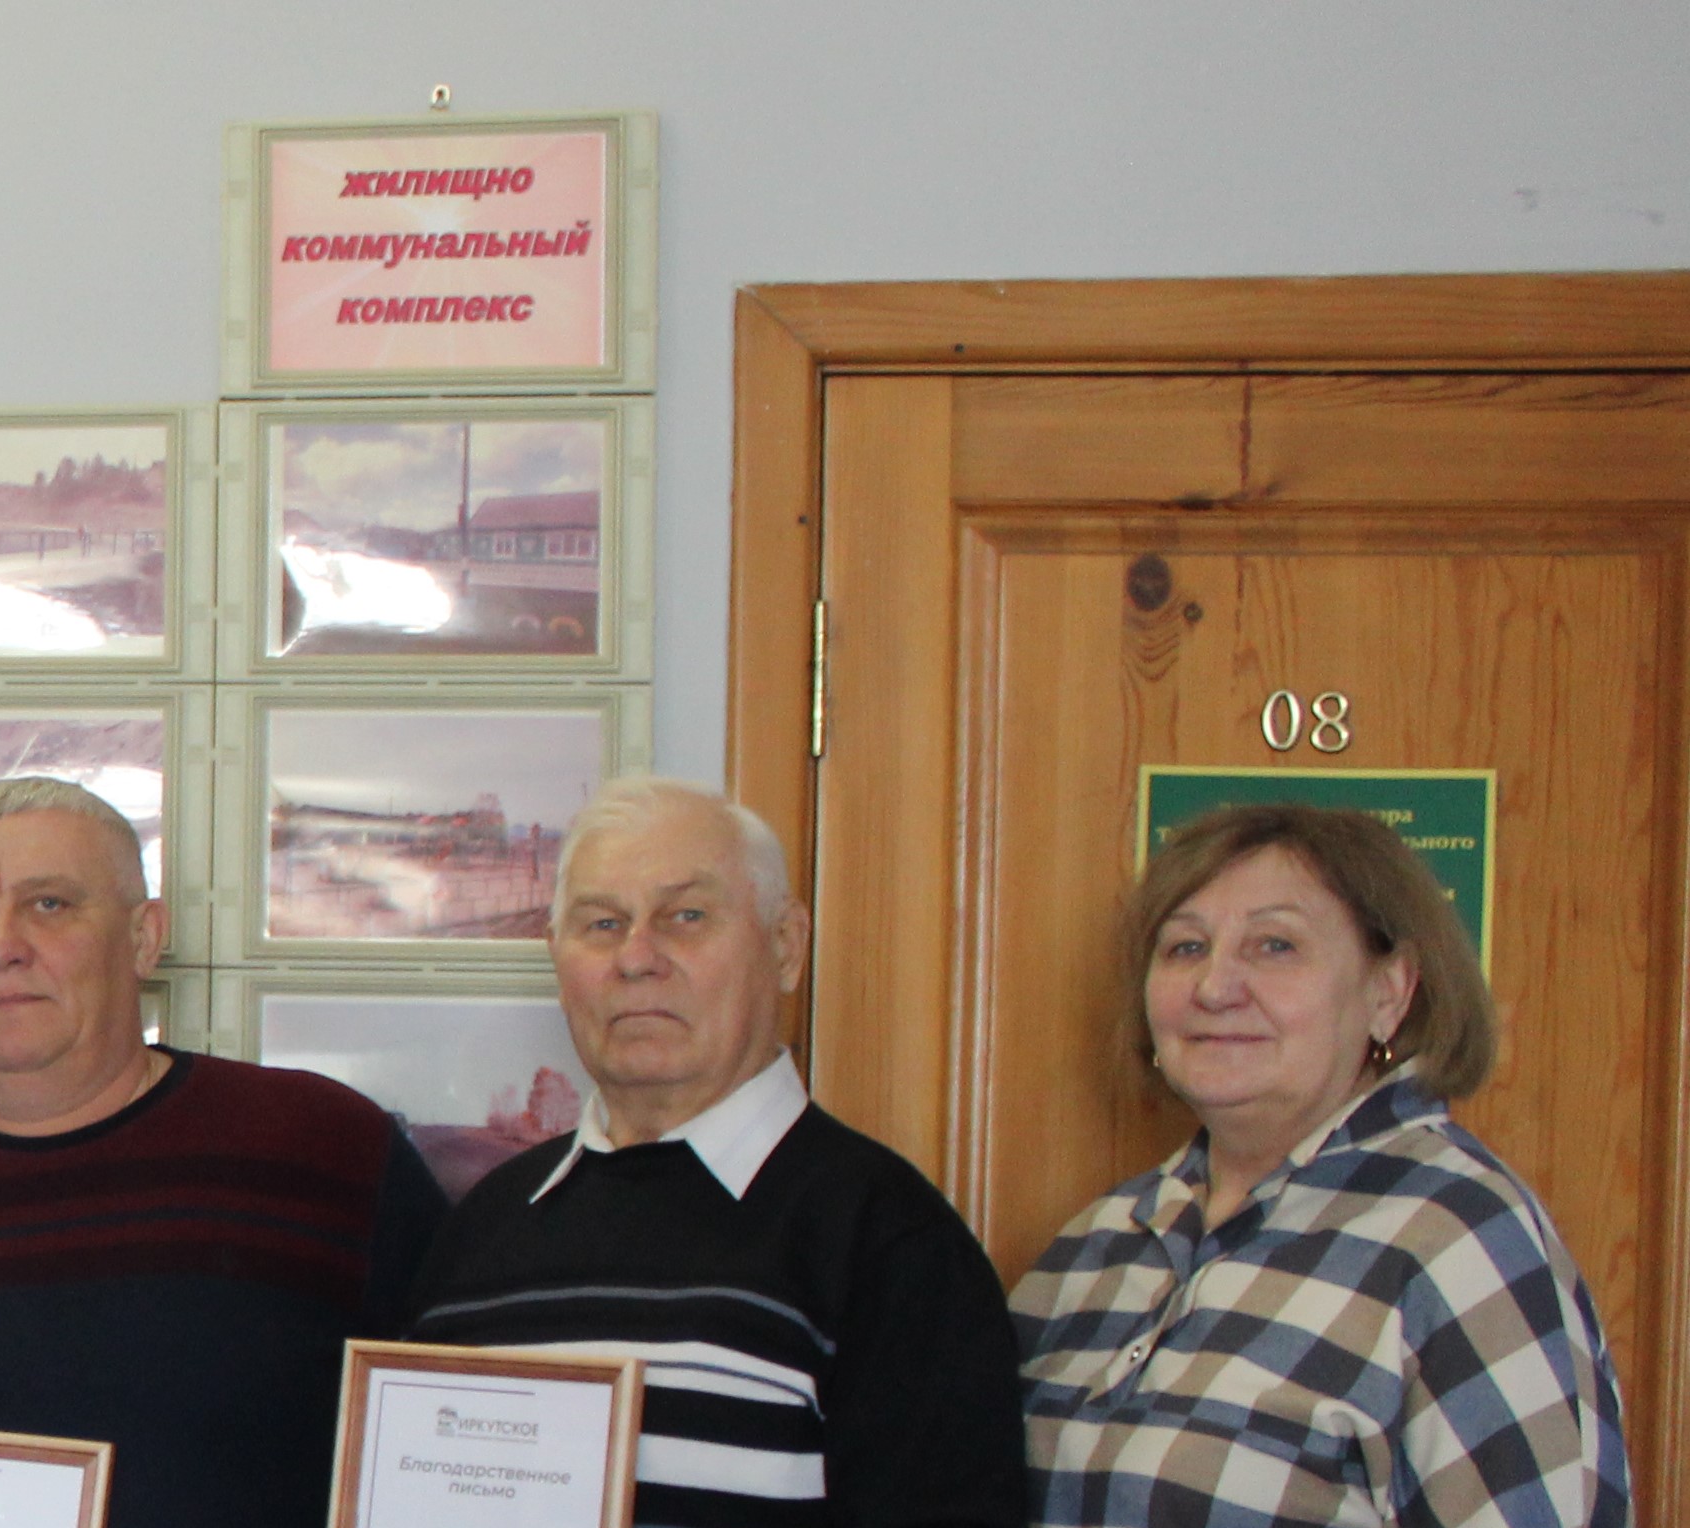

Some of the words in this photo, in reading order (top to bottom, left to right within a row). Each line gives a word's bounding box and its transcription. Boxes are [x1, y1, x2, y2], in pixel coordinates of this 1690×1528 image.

[339, 164, 536, 201] жилищно
[281, 219, 593, 270] коммунальный
[335, 291, 536, 325] комплекс
[1260, 688, 1352, 754] 08
[457, 1417, 540, 1437] ИРКУТСКОЕ
[398, 1455, 573, 1486] Благодарственное
[448, 1480, 517, 1499] письмо
